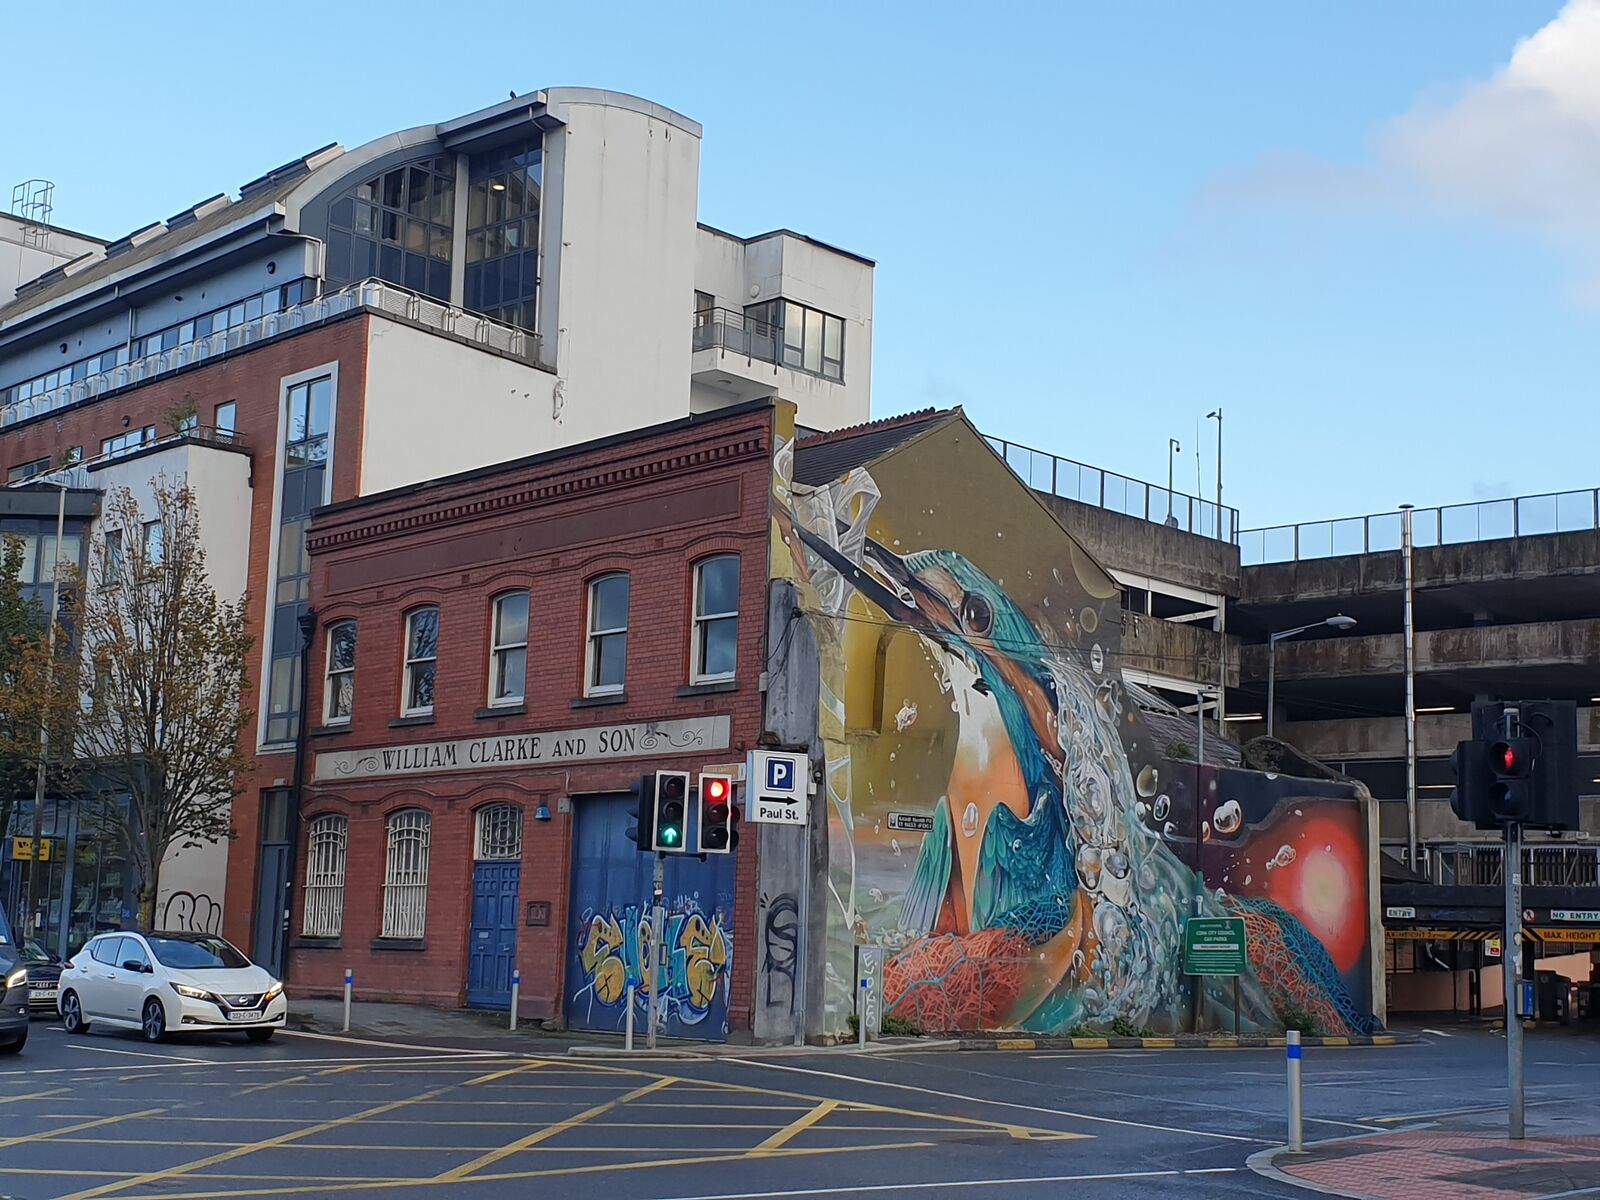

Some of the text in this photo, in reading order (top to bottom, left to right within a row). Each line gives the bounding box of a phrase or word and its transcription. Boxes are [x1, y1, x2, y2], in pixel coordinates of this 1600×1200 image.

[382, 728, 636, 770] WILLIAM CLARKE AND SON
[773, 763, 787, 786] P
[760, 807, 799, 820] Paul St.
[1388, 909, 1412, 917] ENTRY
[1566, 931, 1597, 940] HEIGHT
